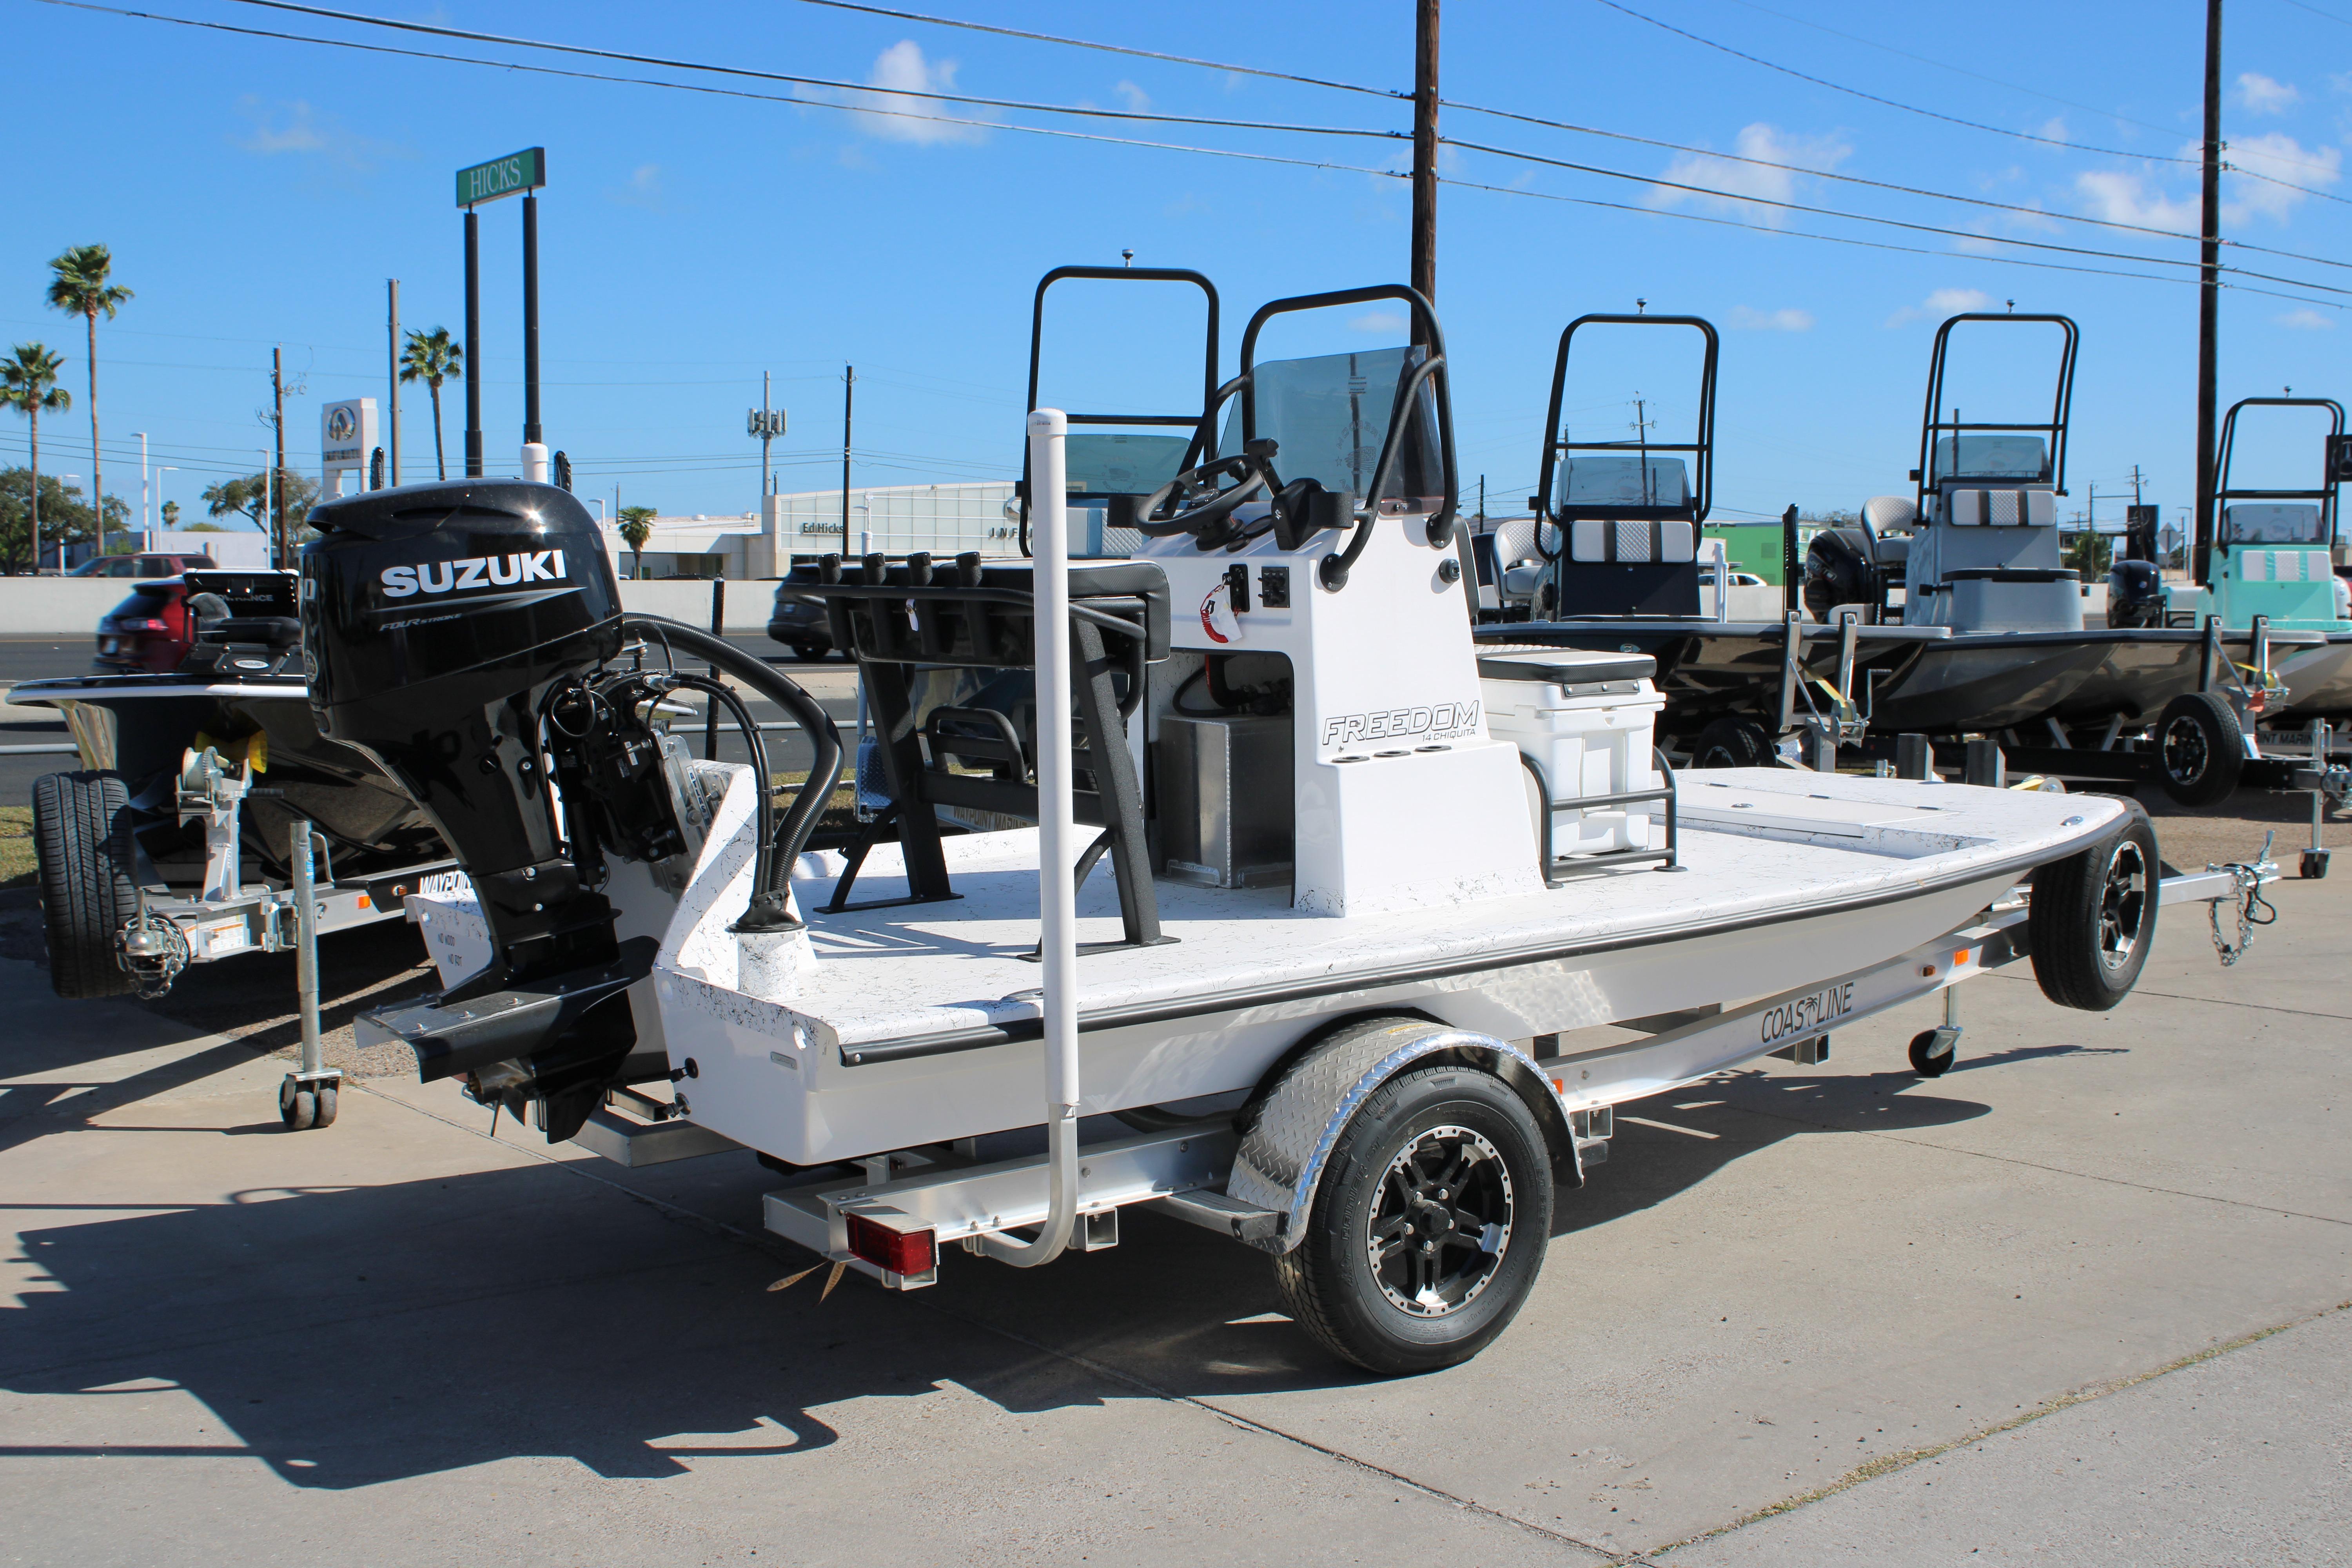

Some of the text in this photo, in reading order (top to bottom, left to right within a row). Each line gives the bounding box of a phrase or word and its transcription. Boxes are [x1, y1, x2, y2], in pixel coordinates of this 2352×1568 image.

[470, 158, 521, 198] HICKS
[381, 550, 566, 597] SUZUKI
[1322, 700, 1479, 745] FREEDOM
[1422, 728, 1475, 742] 14 CHIQUITA
[689, 772, 706, 813] ATLAS
[953, 806, 993, 829] WAYPOINT
[419, 870, 472, 894] WAYPOIN
[438, 933, 455, 946] NO WOOD
[448, 953, 454, 964] NO
[1341, 1164, 1367, 1241] RAINIER
